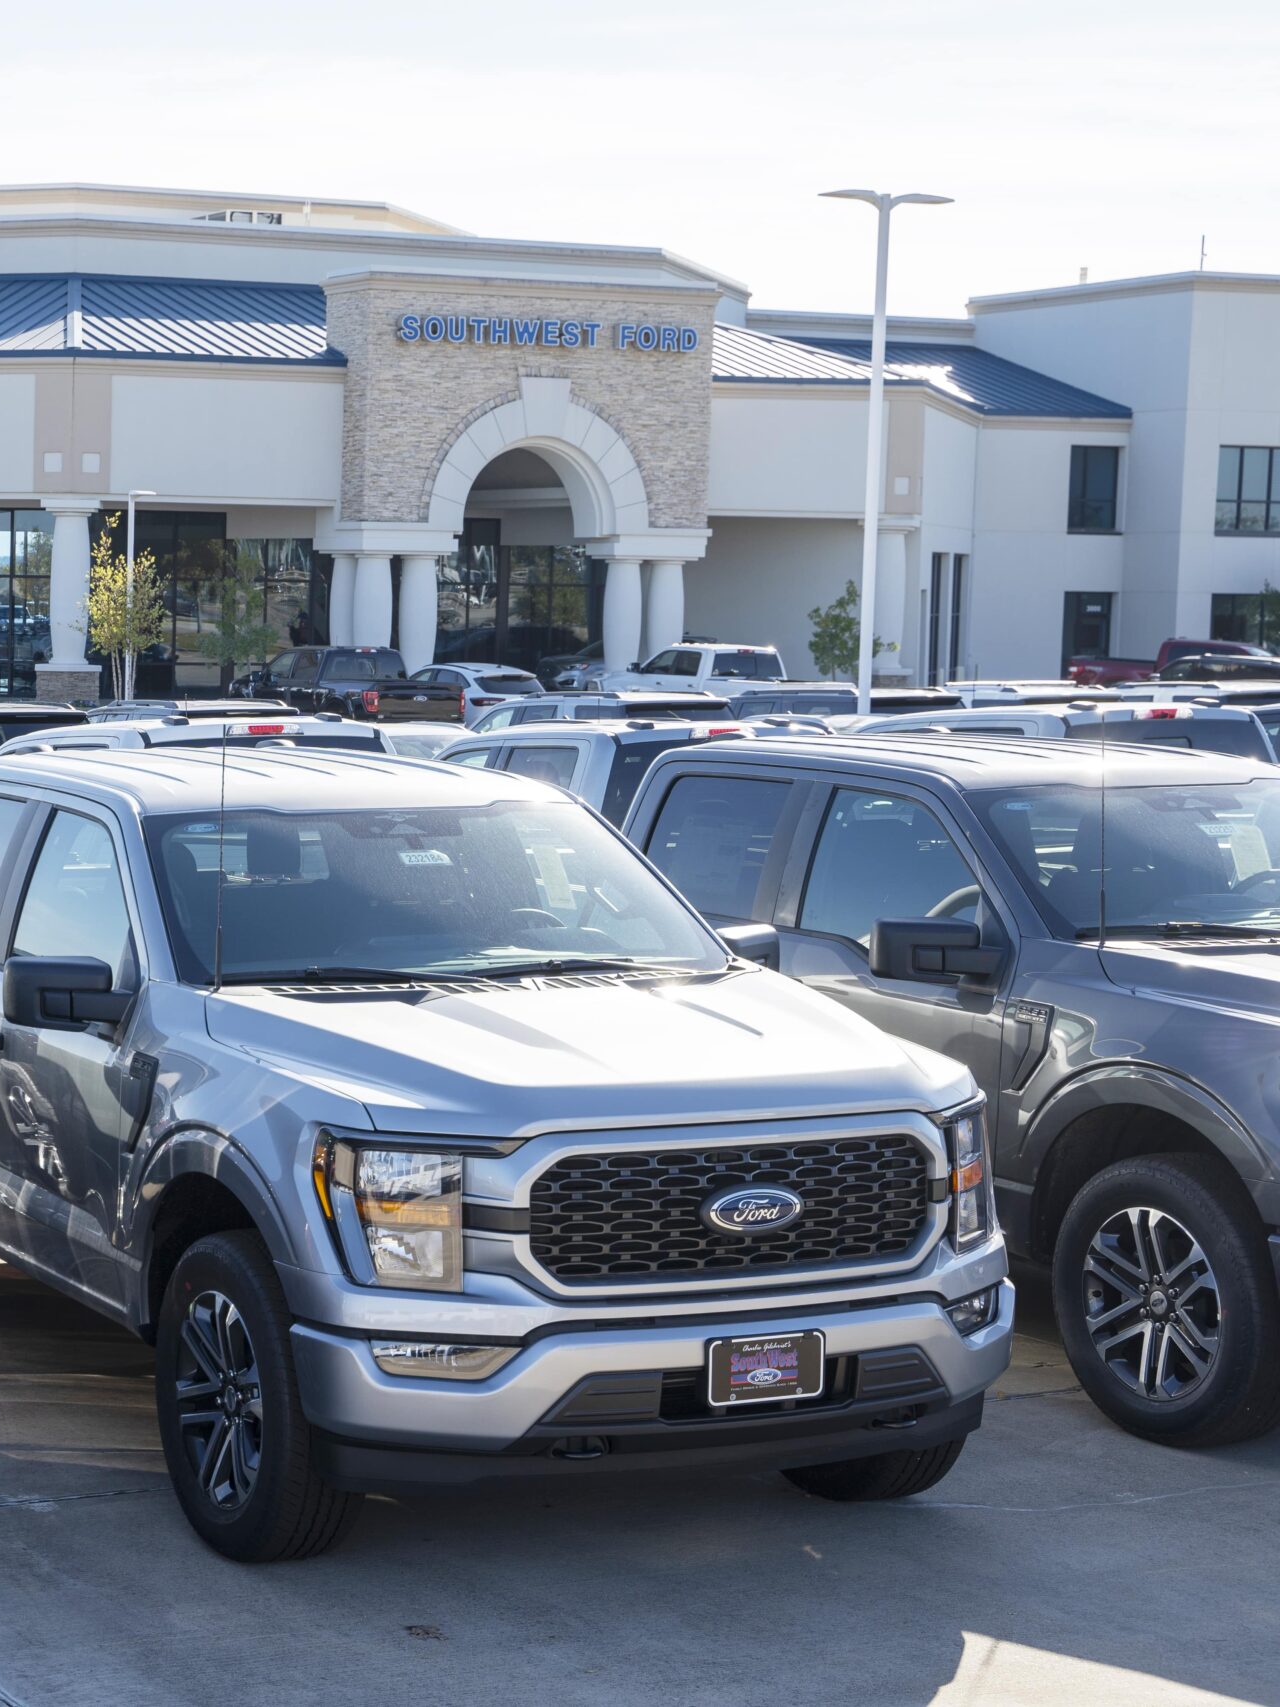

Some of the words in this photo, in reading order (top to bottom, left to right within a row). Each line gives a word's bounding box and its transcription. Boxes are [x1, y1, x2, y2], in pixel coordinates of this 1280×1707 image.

[400, 314, 602, 347] SOUTHWEST
[619, 323, 699, 352] FORD
[733, 1199, 781, 1222] Ford
[754, 1371, 774, 1382] Ford
